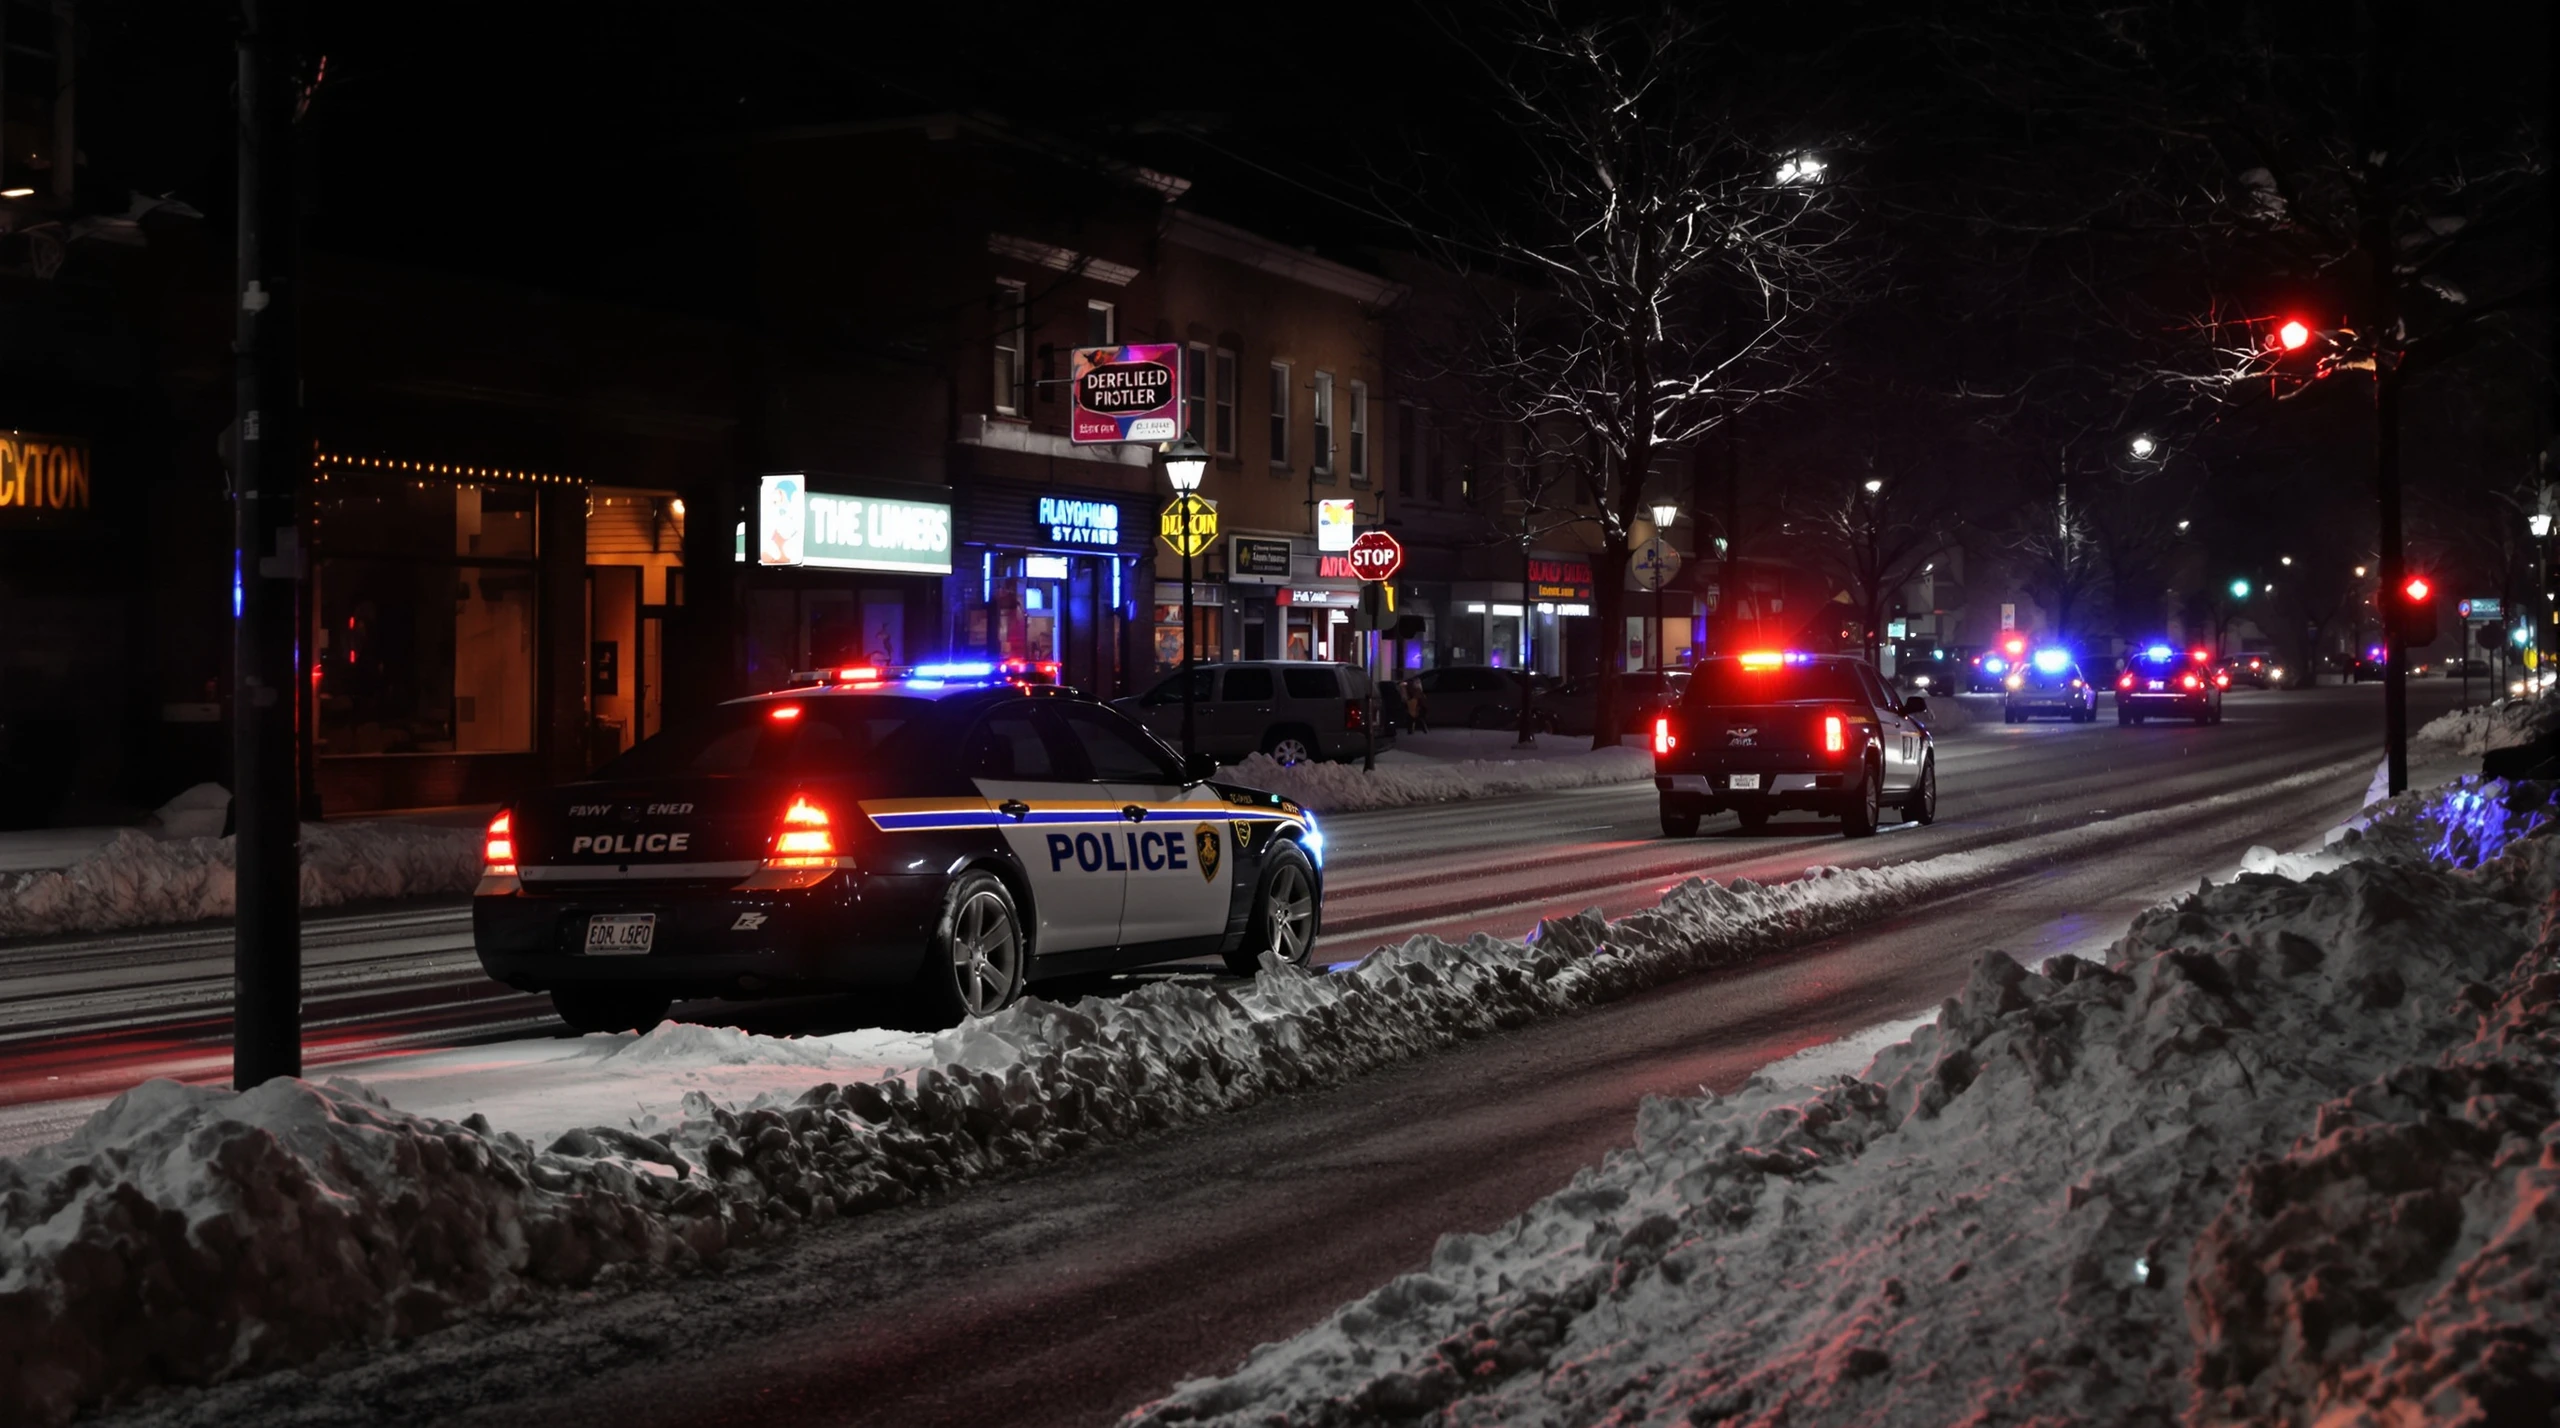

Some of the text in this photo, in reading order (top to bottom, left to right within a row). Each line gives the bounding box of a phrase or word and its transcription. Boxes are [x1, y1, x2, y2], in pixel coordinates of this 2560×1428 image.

[809, 497, 863, 547] THE
[1352, 548, 1395, 567] STOP
[571, 832, 691, 854] POLICE
[1045, 831, 1188, 873] POLICE
